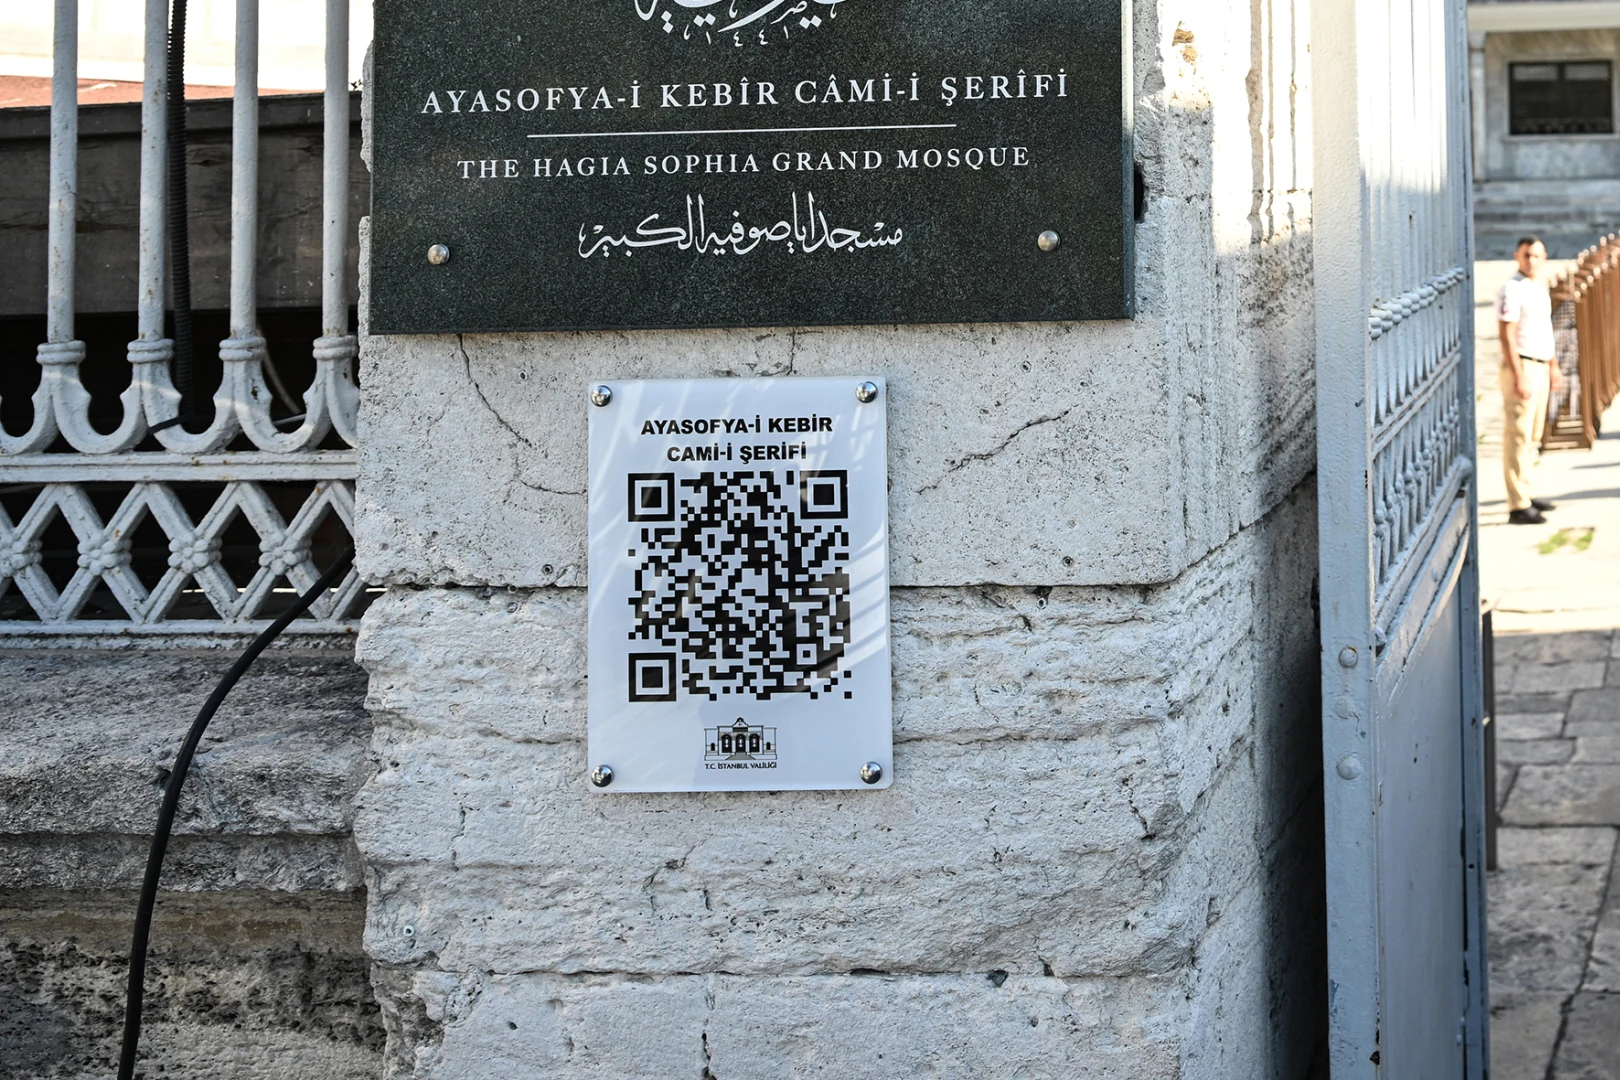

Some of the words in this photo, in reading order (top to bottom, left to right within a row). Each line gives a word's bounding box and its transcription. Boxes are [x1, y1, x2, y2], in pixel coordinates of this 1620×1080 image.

[421, 79, 641, 114] AYASOFYA-İ
[660, 76, 778, 108] KEBÎR
[795, 72, 920, 104] CÂMİ-İ
[457, 159, 520, 179] THE
[534, 156, 631, 178] HAGIA
[644, 153, 760, 175] SOPHIA
[773, 150, 882, 172] GRAND
[897, 146, 1029, 170] MOSQUE
[641, 415, 761, 435] AYASOFYA-İ
[768, 413, 833, 433] KEBİR
[667, 442, 732, 462] CAMİ-İ
[739, 441, 807, 465] ŞERİFİ
[717, 762, 749, 770] İSTANBUL
